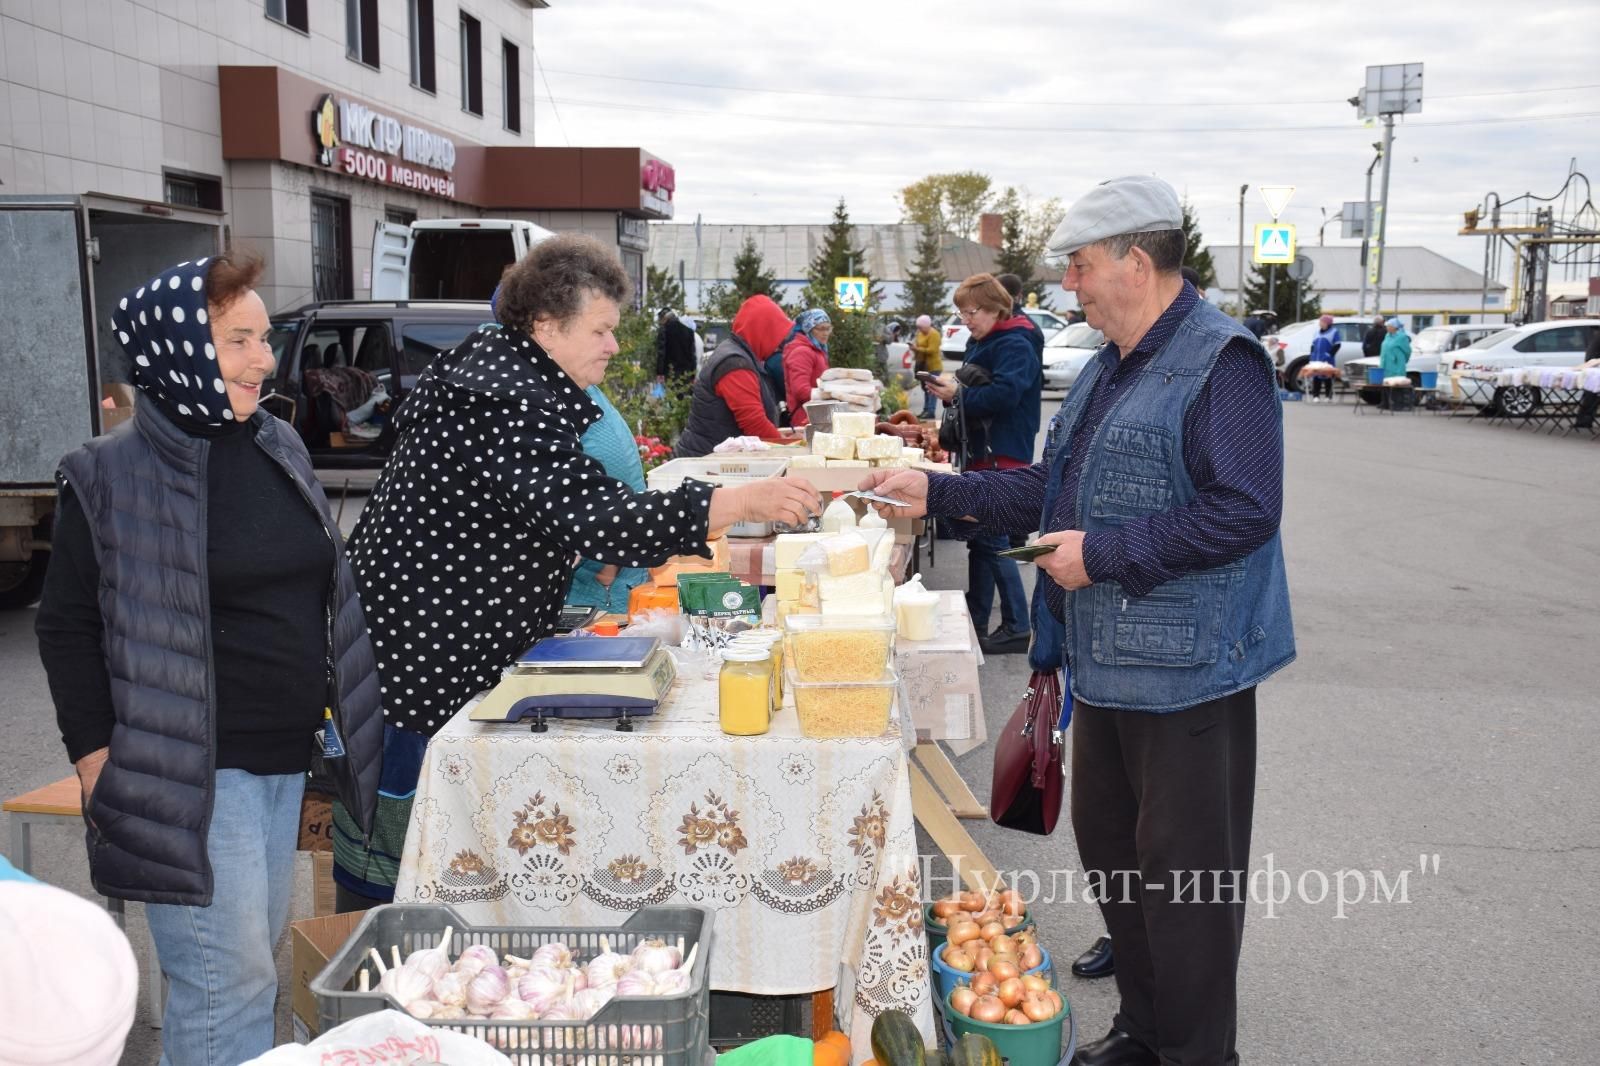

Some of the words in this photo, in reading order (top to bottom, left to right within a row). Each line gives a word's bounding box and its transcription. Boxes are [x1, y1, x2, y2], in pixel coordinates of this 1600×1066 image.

[339, 97, 402, 157] МИСТЕР
[344, 149, 387, 182] 5000
[391, 165, 455, 198] мелочей
